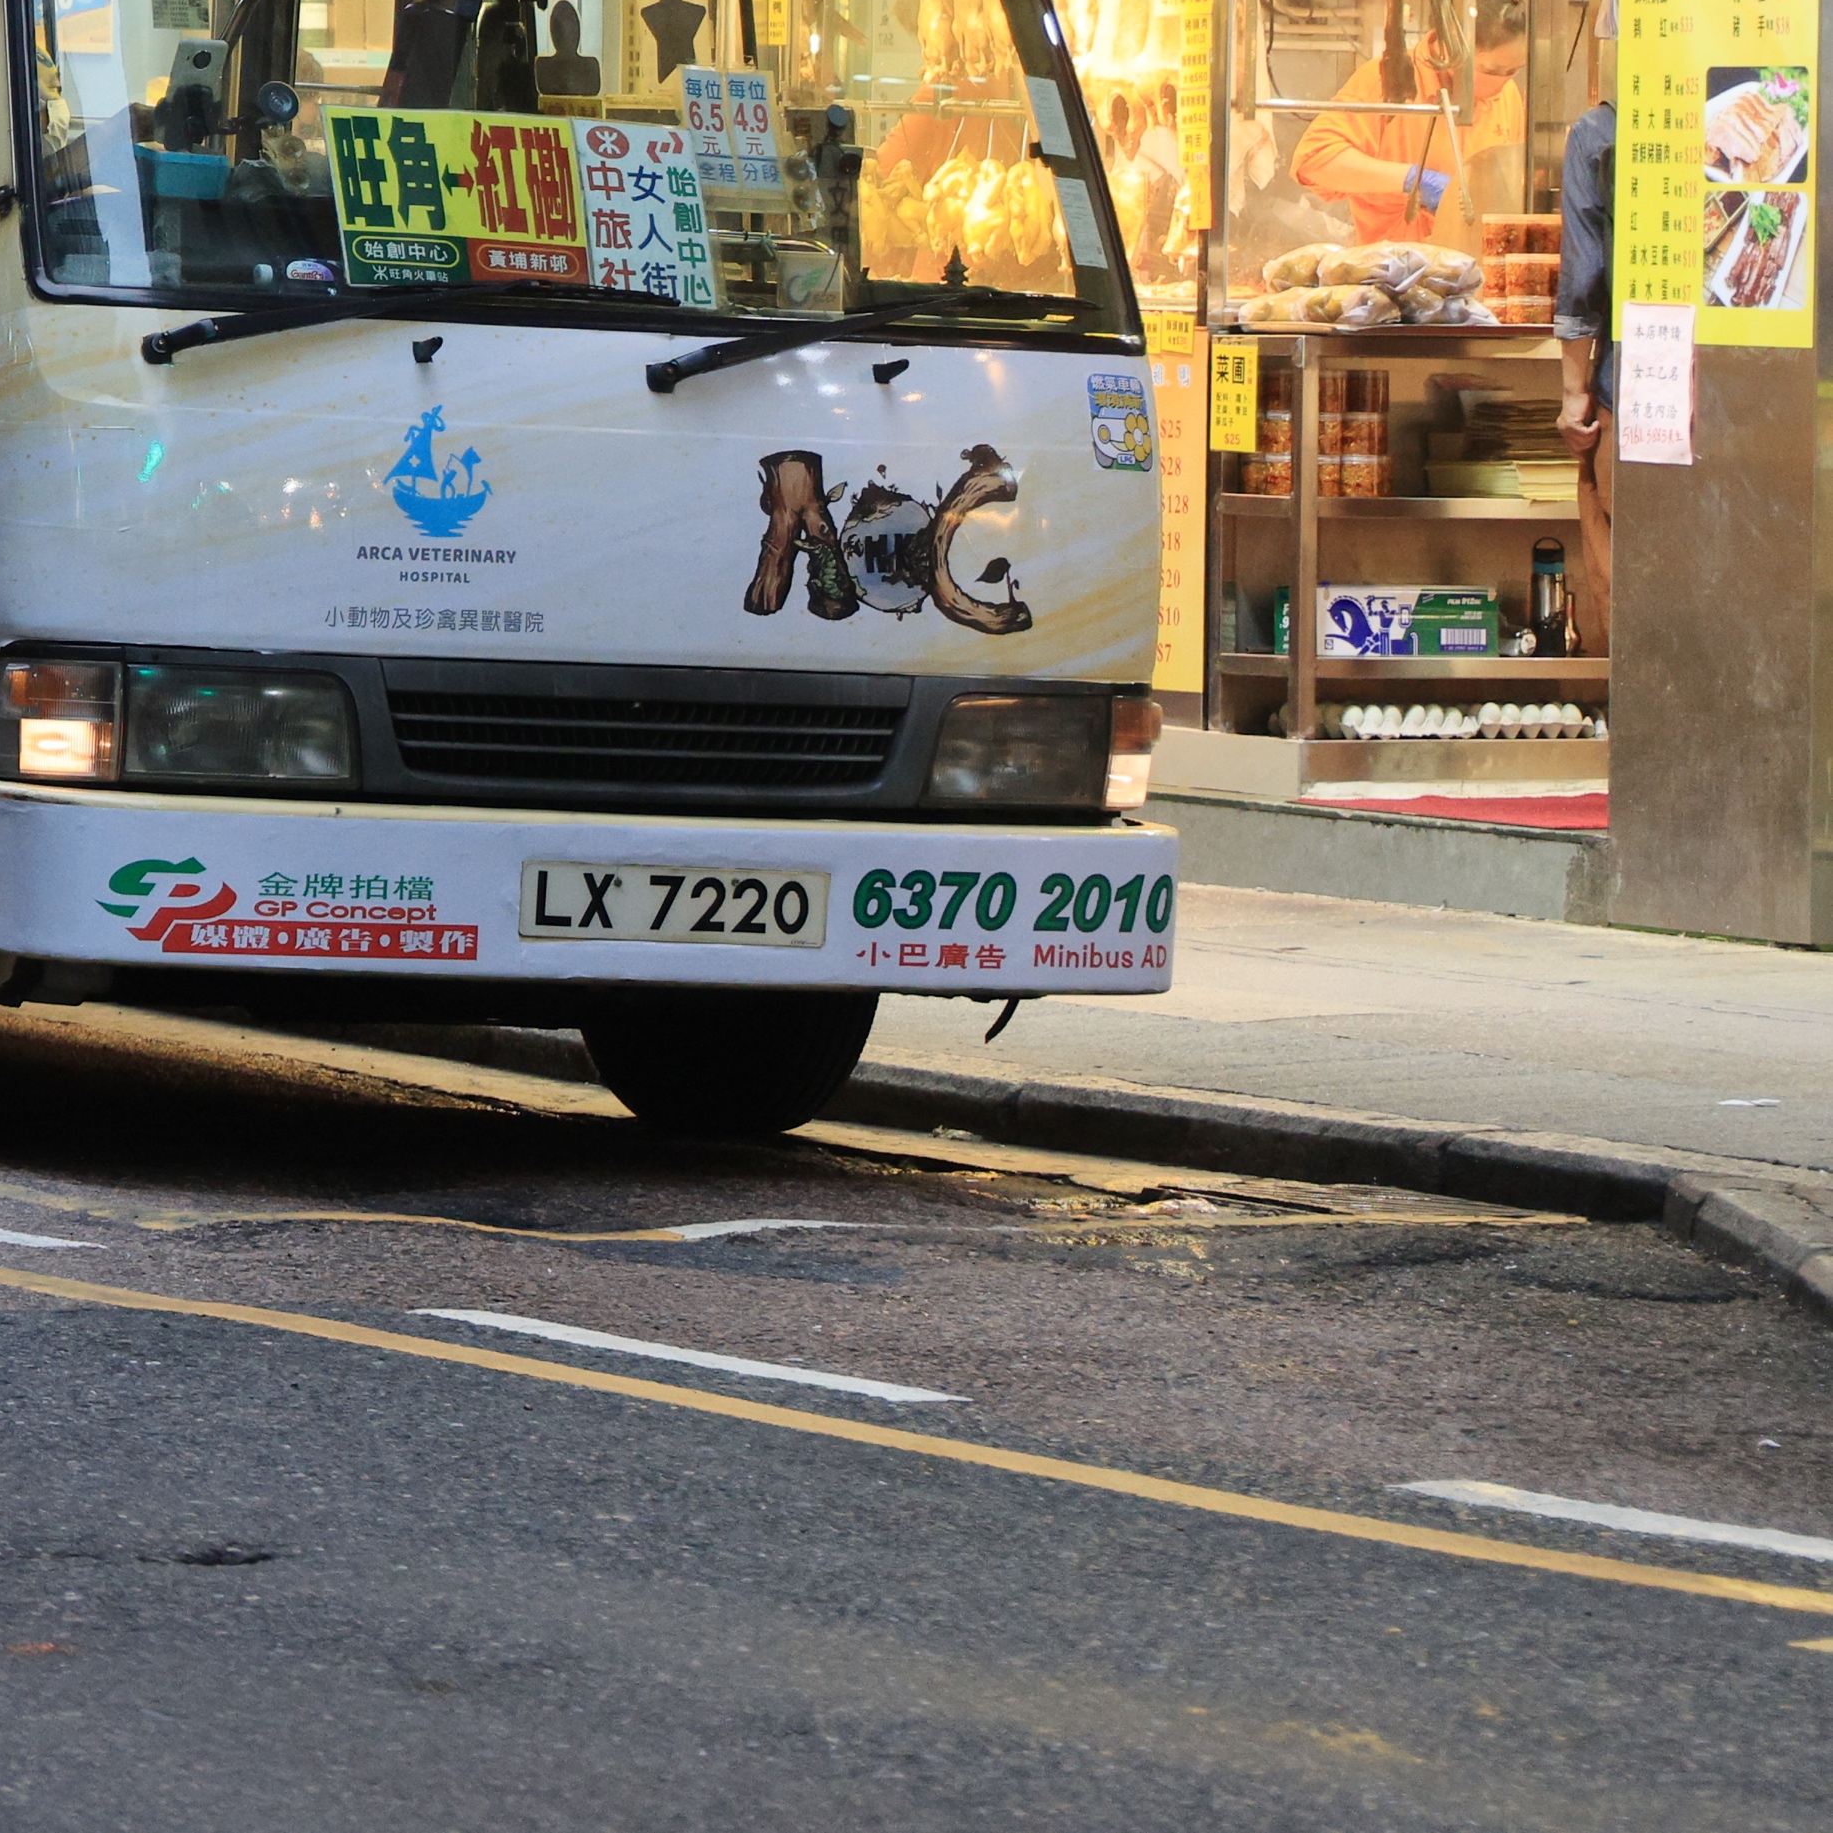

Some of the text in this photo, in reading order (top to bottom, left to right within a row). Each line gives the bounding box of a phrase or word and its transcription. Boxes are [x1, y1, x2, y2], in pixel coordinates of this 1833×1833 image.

[685, 78, 722, 100] 每位
[728, 79, 767, 100] 每位
[1685, 77, 1700, 95] $25
[688, 100, 725, 133] 6.5
[735, 103, 769, 134] 4.9
[1685, 112, 1699, 129] $28
[702, 136, 721, 156] 元
[746, 136, 765, 156] 元
[1684, 146, 1703, 164] $128
[330, 115, 578, 242] 旺角 紅磡
[700, 161, 737, 183] 全程
[743, 161, 781, 184] 分段
[587, 160, 636, 291] 中旅社
[627, 164, 678, 304] 女人街
[1683, 215, 1697, 233] $20
[666, 165, 713, 306] 始創中心
[364, 240, 449, 263] 始創中心
[488, 249, 568, 274] 黃埔新邨
[388, 267, 449, 284] 旺角火車站
[1216, 354, 1246, 384] 菜圃
[1633, 364, 1679, 381] 女工乙名
[1160, 420, 1182, 439] $25
[1224, 432, 1241, 445] $25
[1119, 455, 1134, 465] LPG
[1160, 456, 1182, 477] $28
[356, 545, 517, 564] ARCA VETERINARY
[399, 571, 471, 584] HOSPITAL
[1160, 568, 1181, 588] $20
[324, 606, 545, 634] 小動物及珍禽異獸醫院
[1158, 606, 1181, 626] $10
[1157, 643, 1172, 663] $7
[257, 871, 434, 901] 金牌拍檔
[534, 870, 810, 935] LX 7220
[851, 868, 1174, 934] 6370 2010
[253, 900, 438, 925] GP Concept
[855, 942, 1008, 970] 小巴廣告
[1032, 942, 1168, 970] Minibus AD
